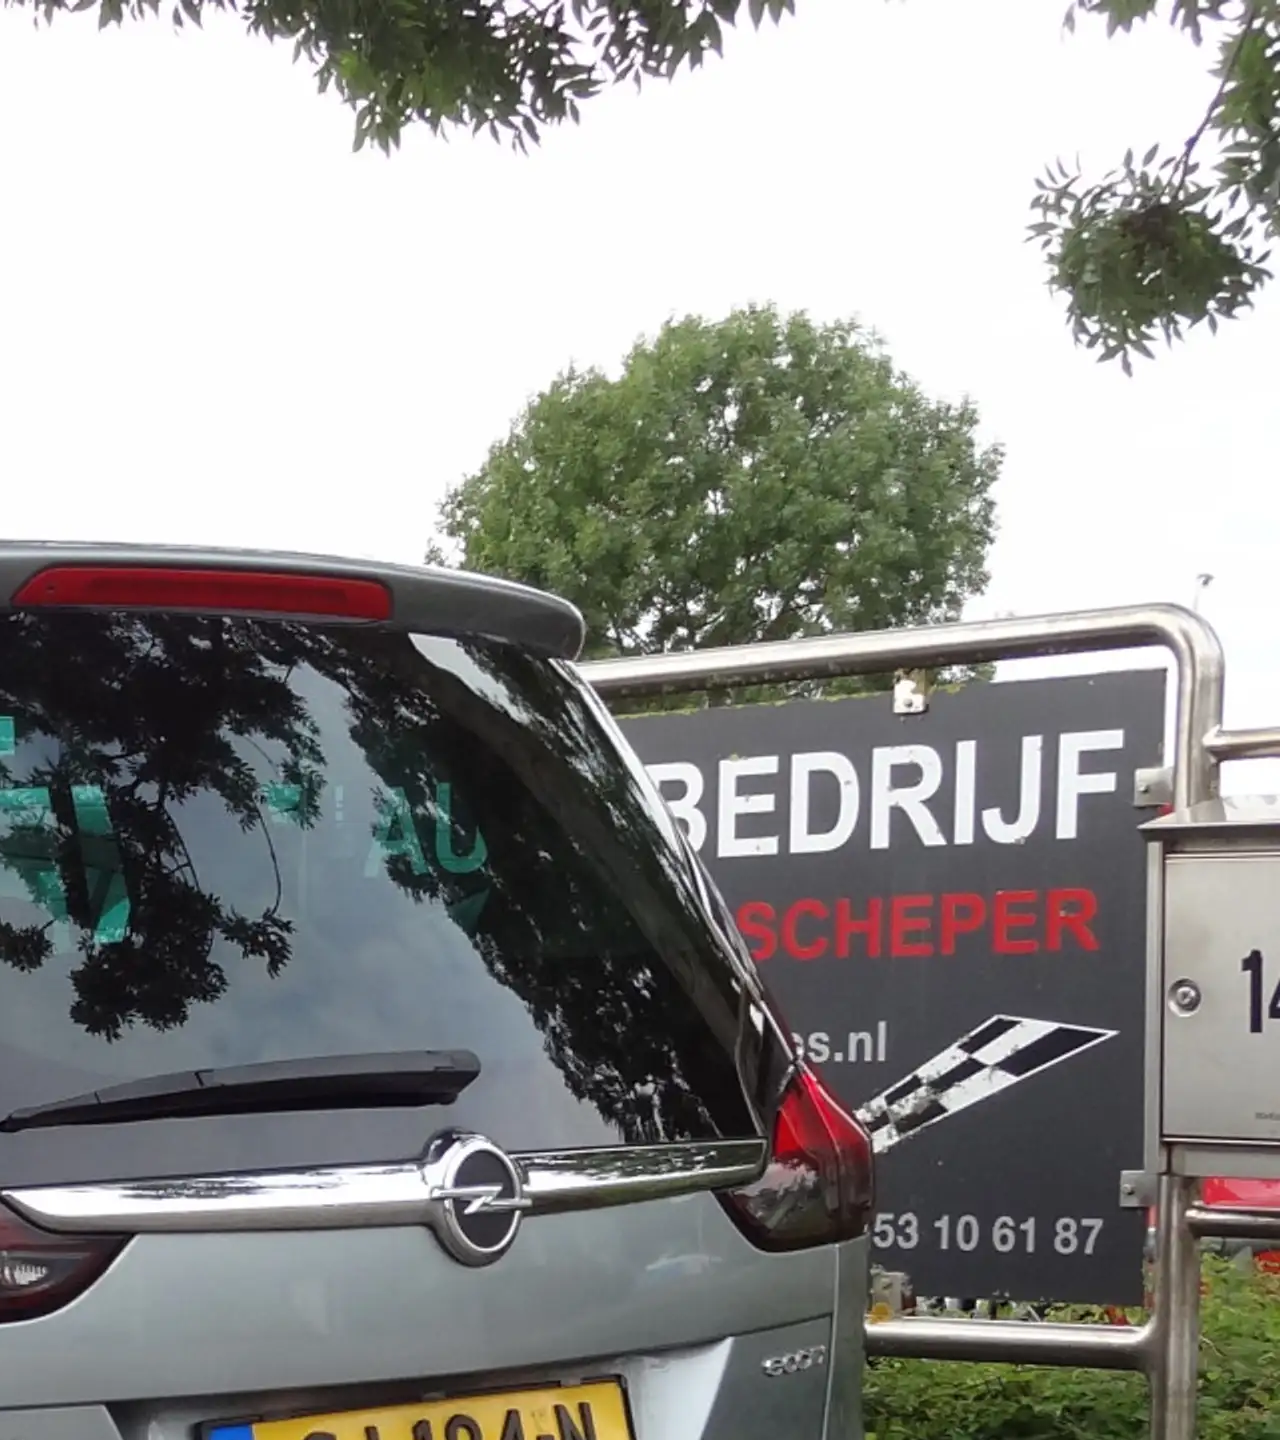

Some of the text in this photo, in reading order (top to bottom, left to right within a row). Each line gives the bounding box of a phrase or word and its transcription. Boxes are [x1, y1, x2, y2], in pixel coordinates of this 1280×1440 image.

[736, 888, 1100, 961] SCHEPER
[934, 1214, 980, 1252] 10
[992, 1215, 1036, 1254] 61
[1053, 1217, 1104, 1256] 87
